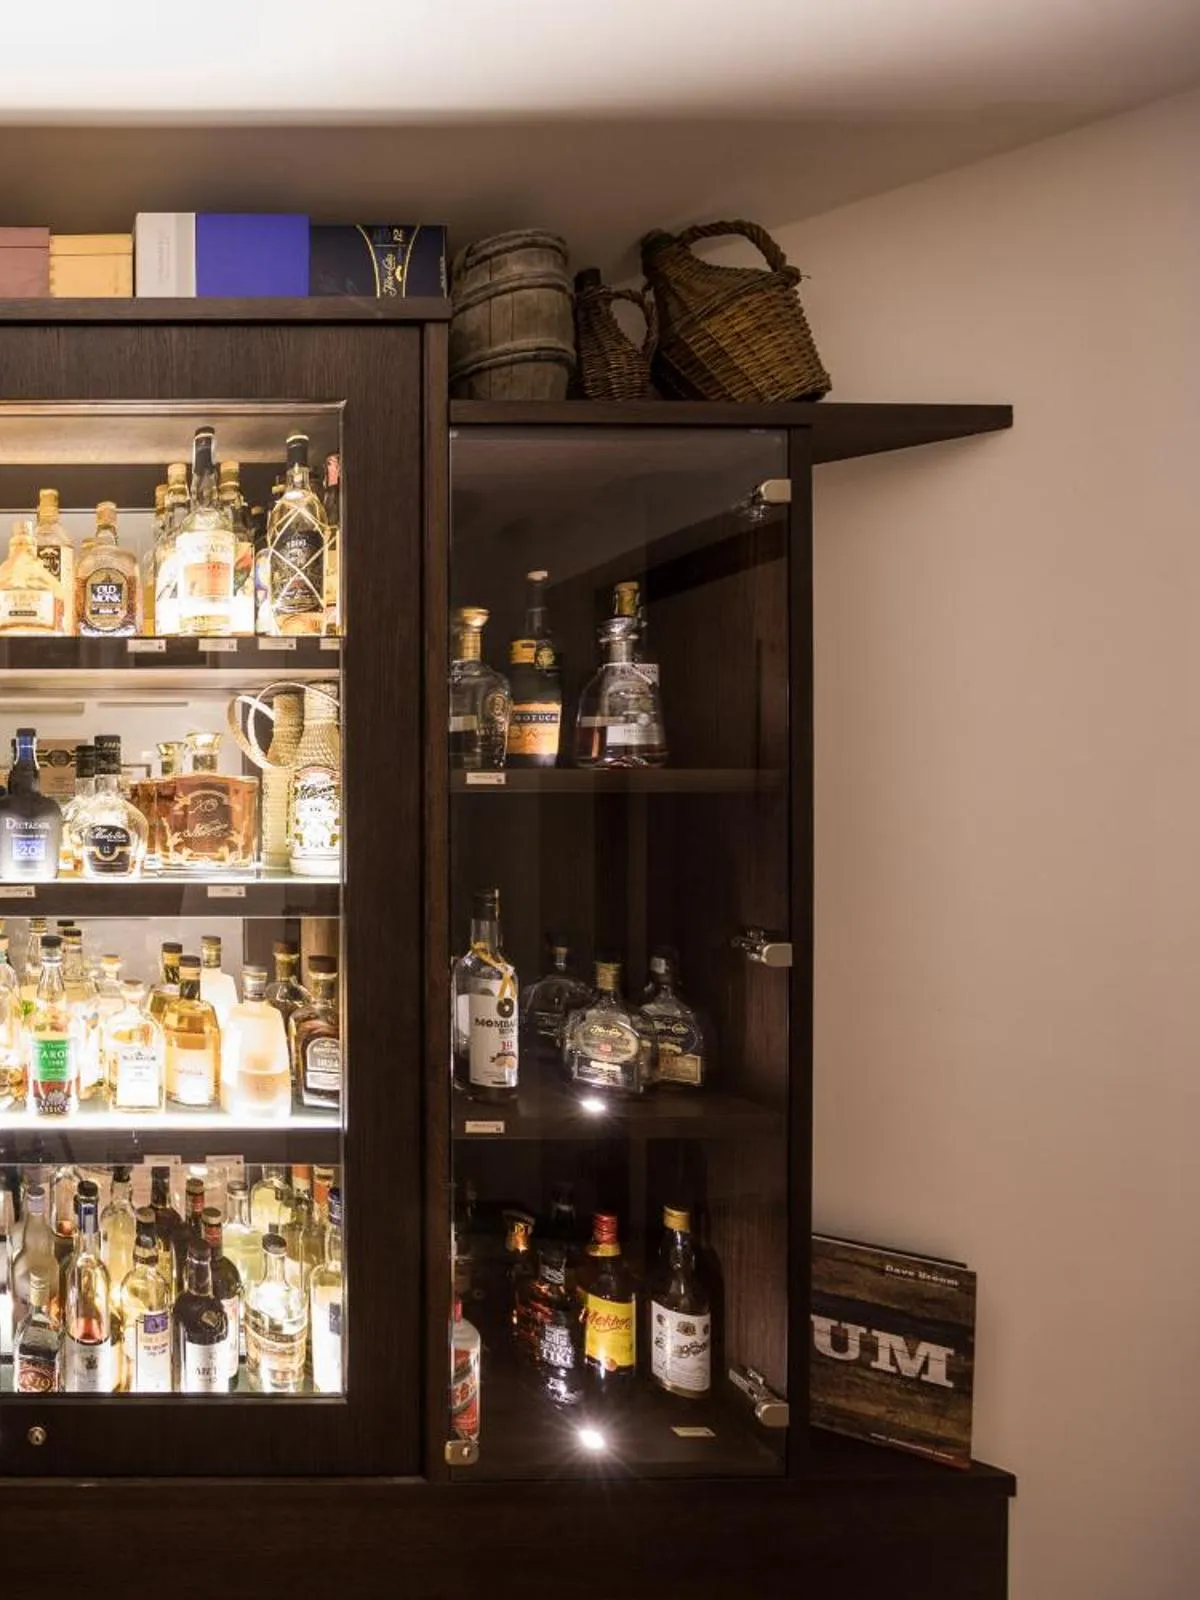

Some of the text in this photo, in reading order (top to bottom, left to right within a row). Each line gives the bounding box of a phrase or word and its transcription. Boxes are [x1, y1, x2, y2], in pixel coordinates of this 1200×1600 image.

[96, 584, 117, 594] OLD
[474, 1018, 516, 1028] MOMBA
[885, 1264, 915, 1277] Dave
[810, 1314, 954, 1388] UM
